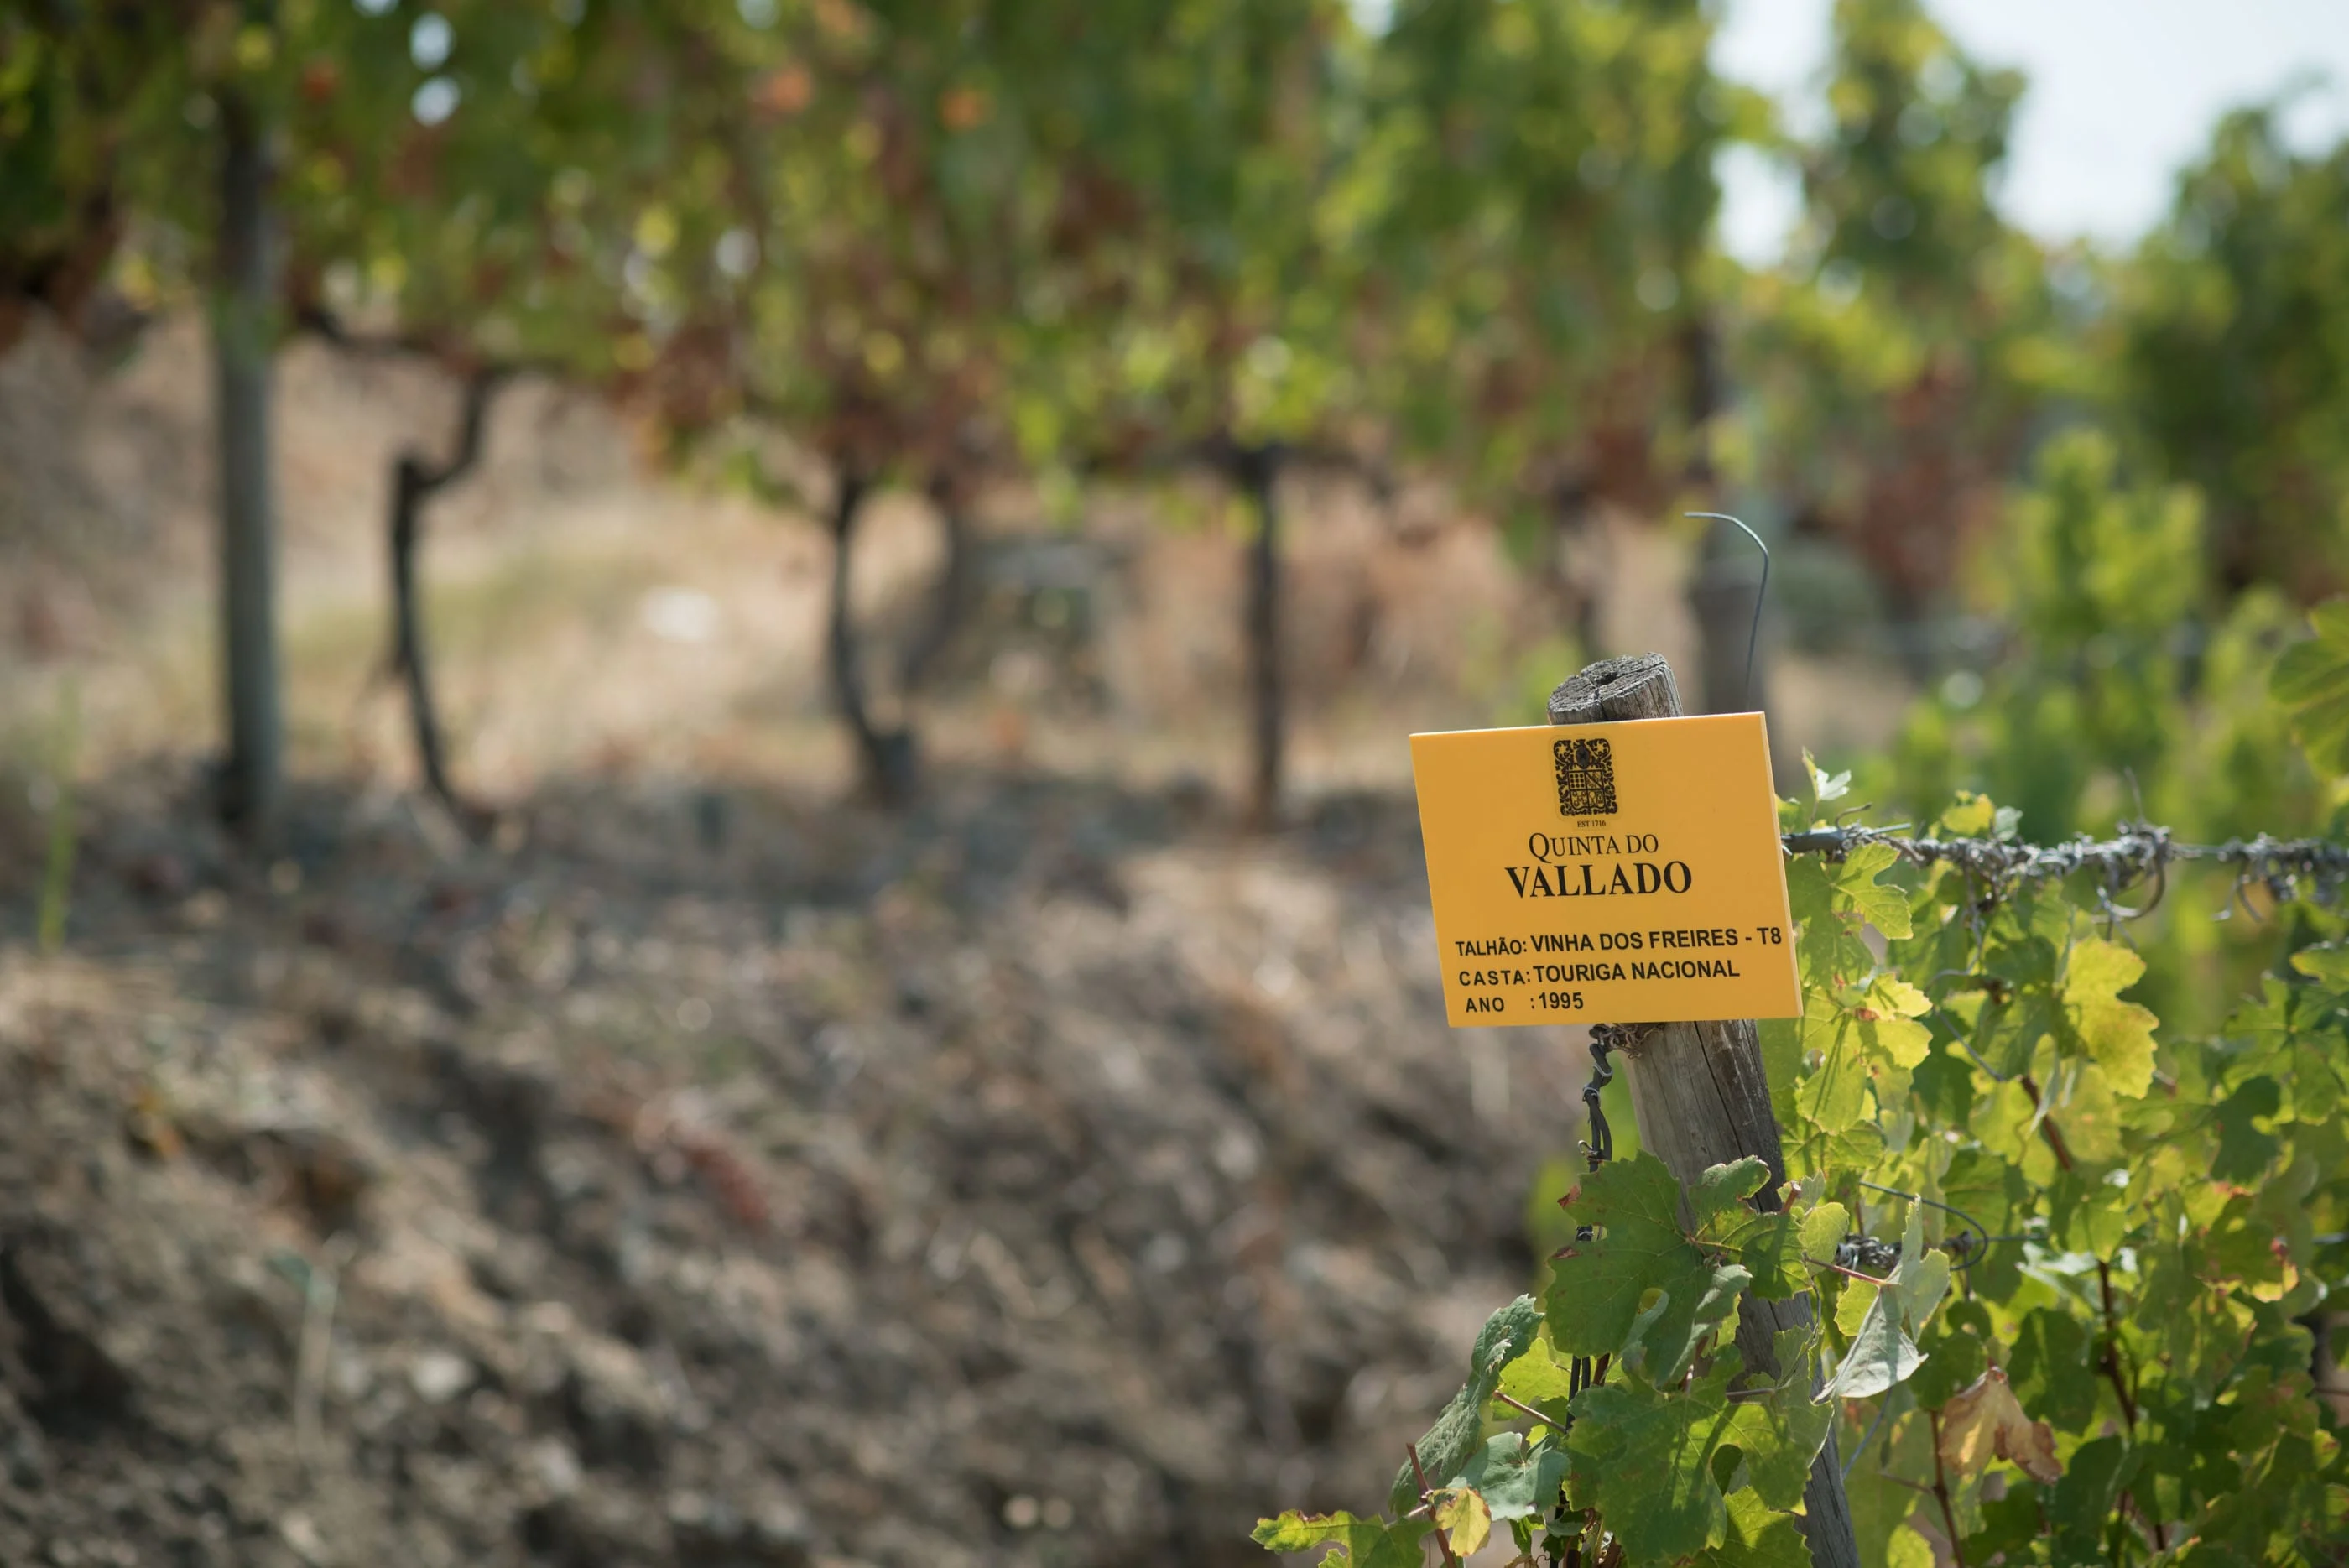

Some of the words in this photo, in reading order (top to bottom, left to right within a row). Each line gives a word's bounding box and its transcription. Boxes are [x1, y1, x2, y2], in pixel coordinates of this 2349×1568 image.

[1529, 832, 1621, 864] QUINTA
[1625, 834, 1659, 854] DO
[1504, 860, 1692, 899] VALLADO
[1455, 937, 1528, 956] TALHÃO:
[1529, 933, 1595, 952] VINHA
[1599, 931, 1643, 951] DOS
[1648, 929, 1739, 949] FREIRES
[1756, 926, 1782, 945] T8
[1532, 963, 1627, 983] TOURIGA
[1631, 959, 1741, 980] NACIONAL
[1466, 997, 1505, 1013] ANO
